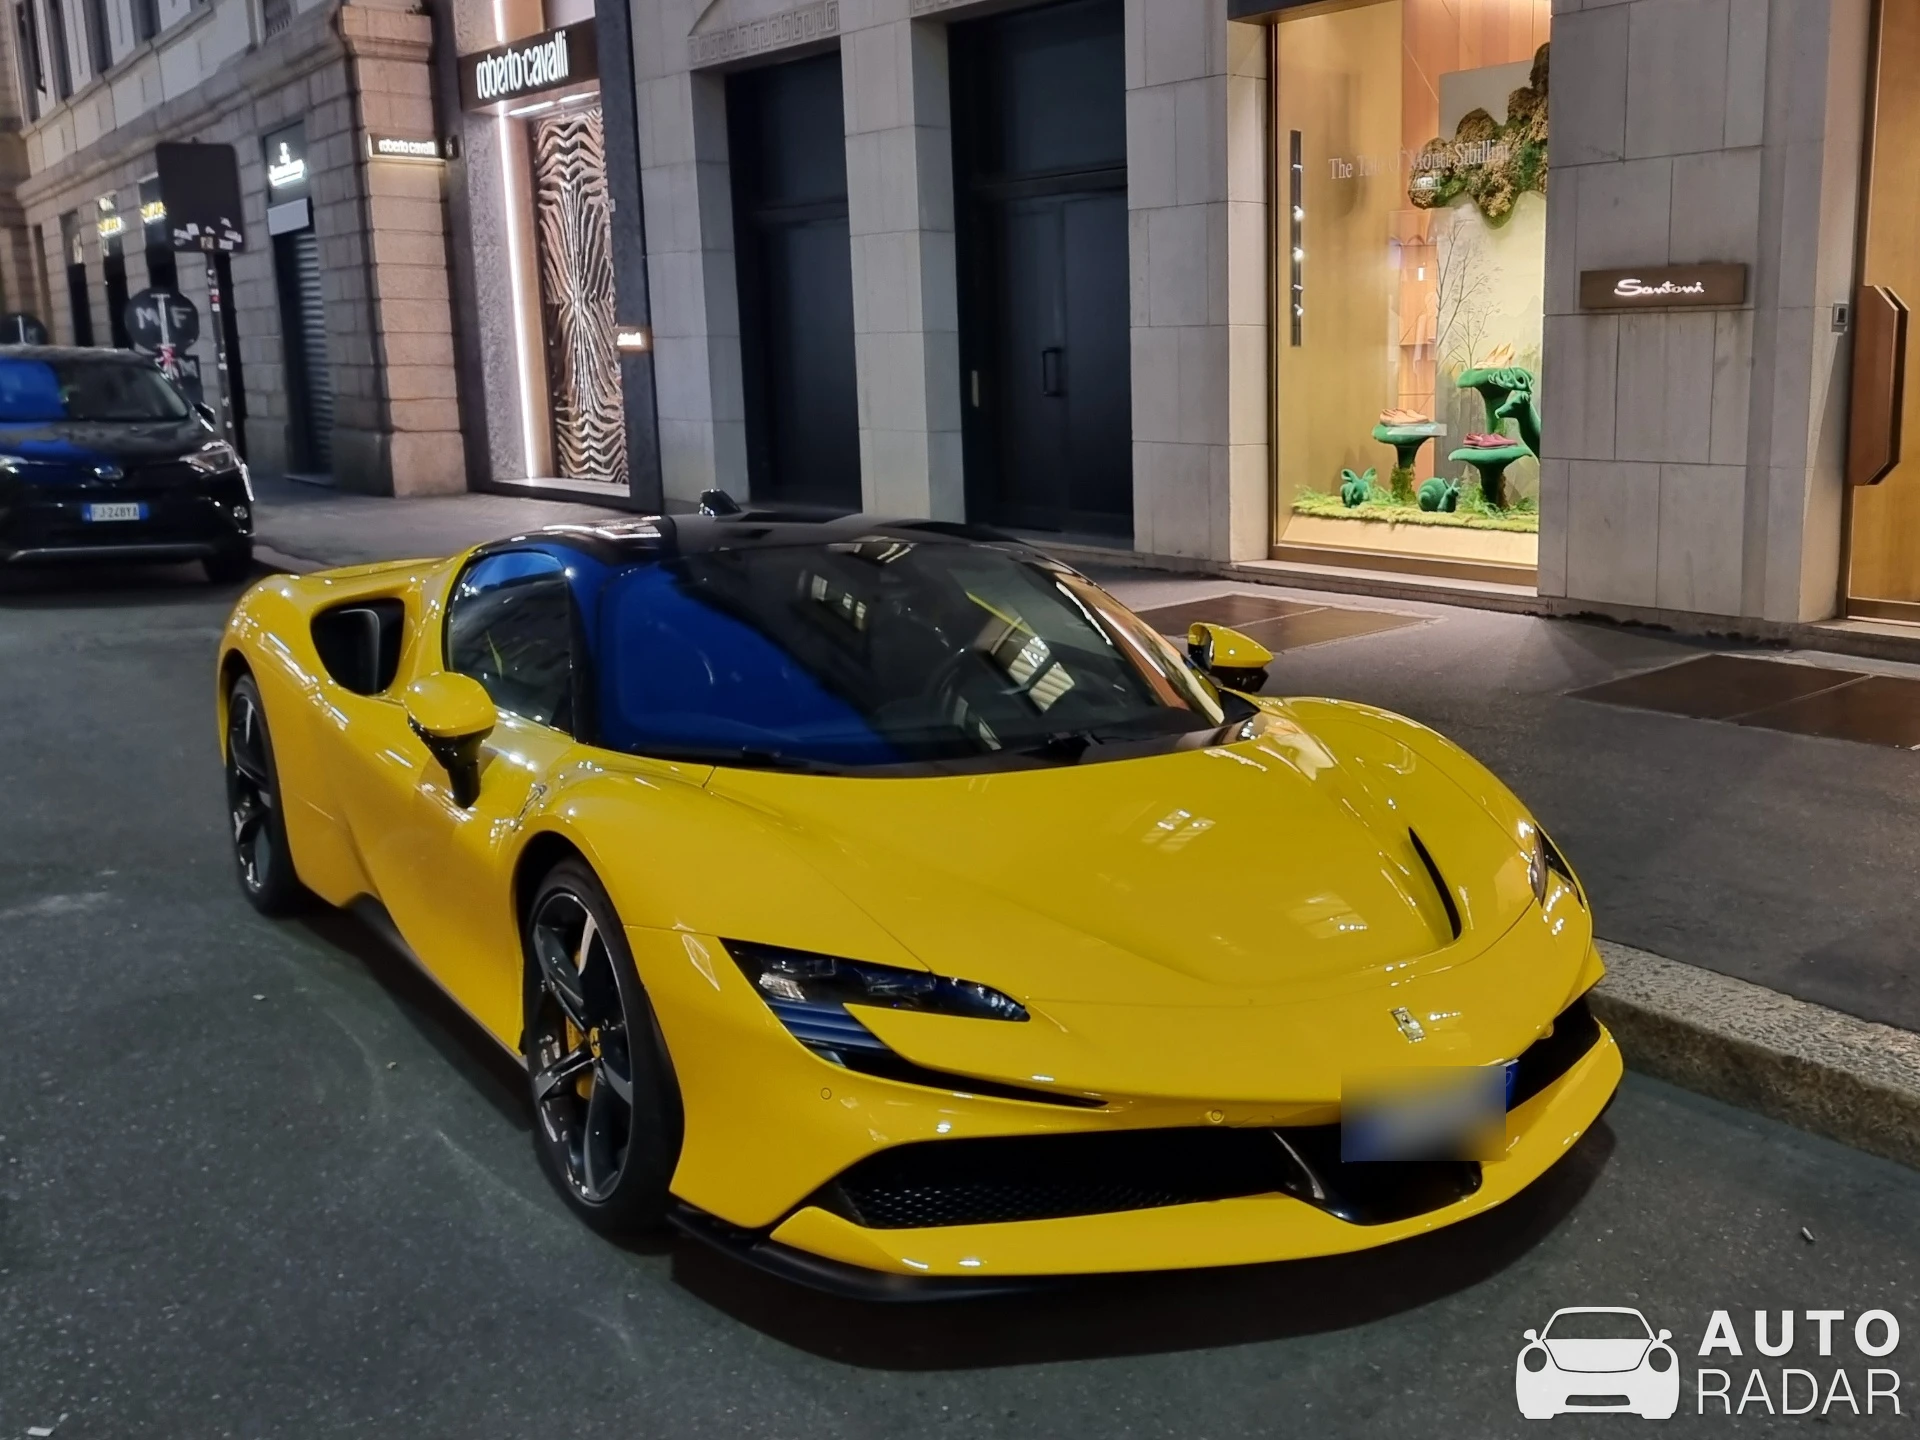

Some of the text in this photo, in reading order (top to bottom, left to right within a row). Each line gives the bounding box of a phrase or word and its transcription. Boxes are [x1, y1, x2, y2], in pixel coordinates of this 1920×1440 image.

[476, 30, 568, 99] roberto cavalli
[1328, 157, 1353, 180] The
[1614, 278, 1705, 296] Santoni
